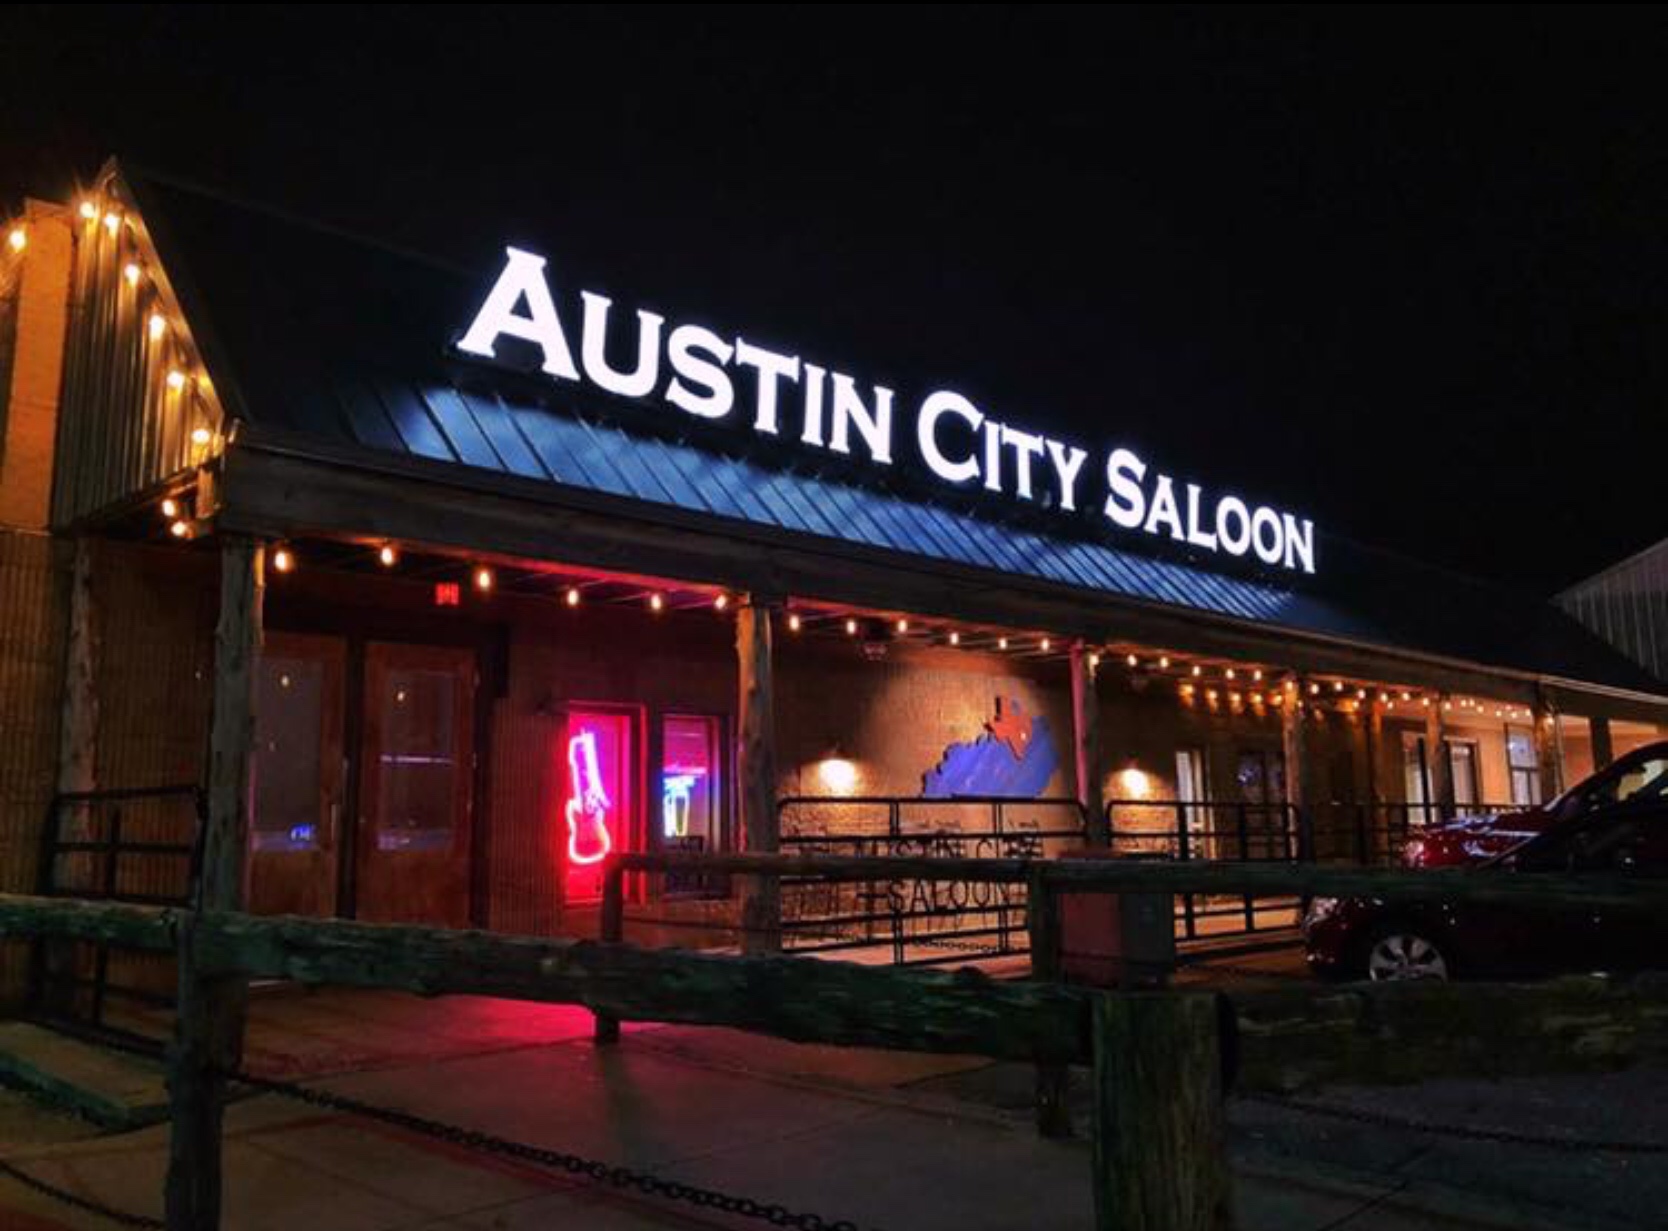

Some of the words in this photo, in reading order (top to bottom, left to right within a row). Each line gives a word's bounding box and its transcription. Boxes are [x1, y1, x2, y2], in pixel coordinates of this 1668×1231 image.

[457, 246, 894, 464] AUSTIN
[917, 390, 1087, 511] CITY
[1104, 448, 1316, 574] SALOON
